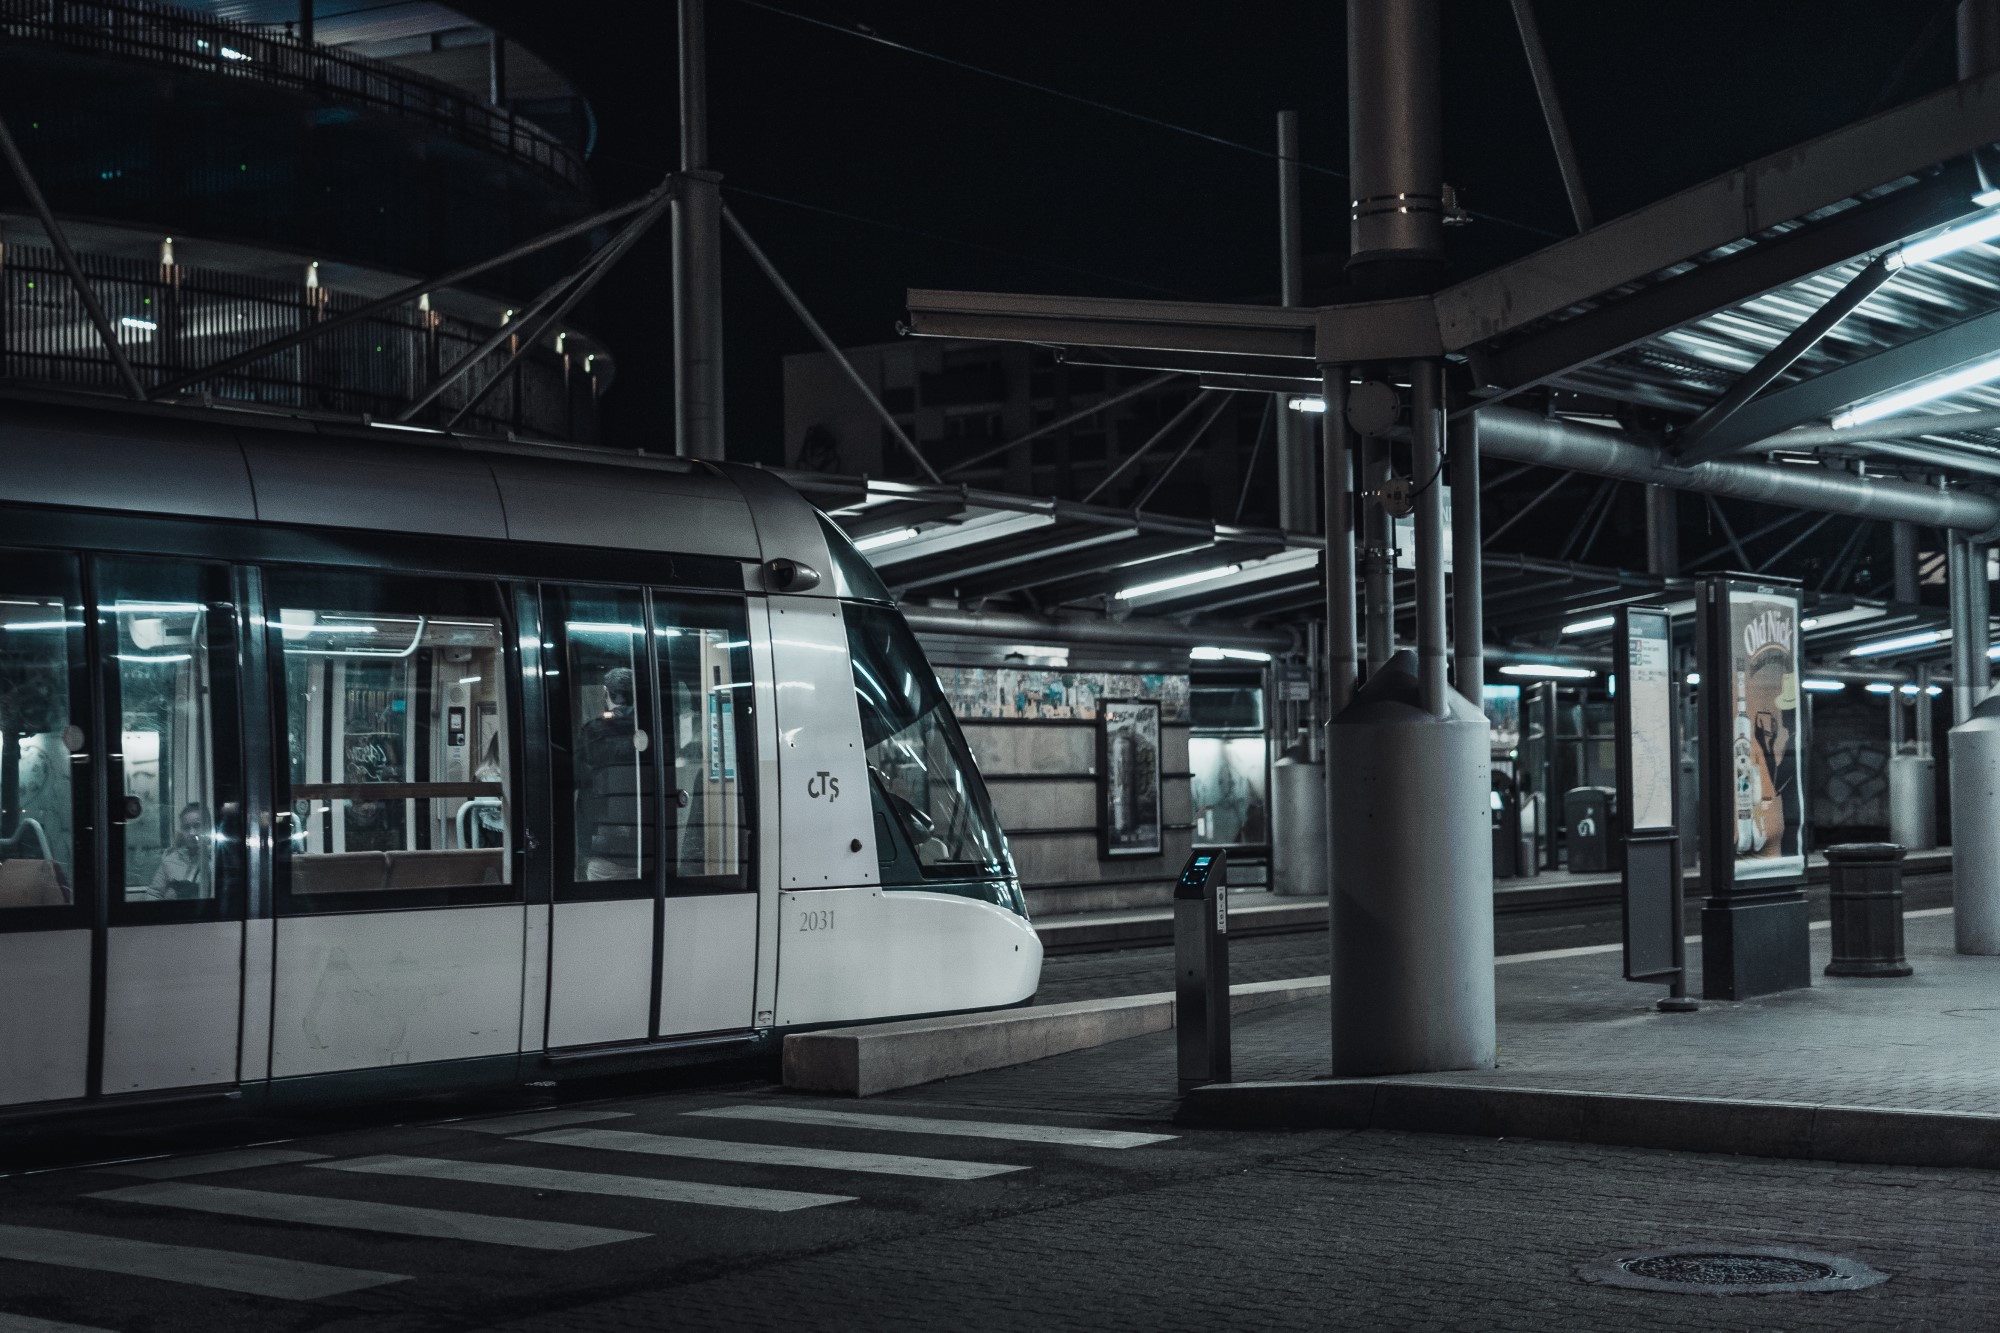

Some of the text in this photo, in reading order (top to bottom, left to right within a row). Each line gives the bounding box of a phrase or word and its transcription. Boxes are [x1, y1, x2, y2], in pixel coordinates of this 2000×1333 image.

[1745, 610, 1792, 655] Old Nick
[808, 771, 839, 803] CTS
[799, 910, 834, 931] 2031
